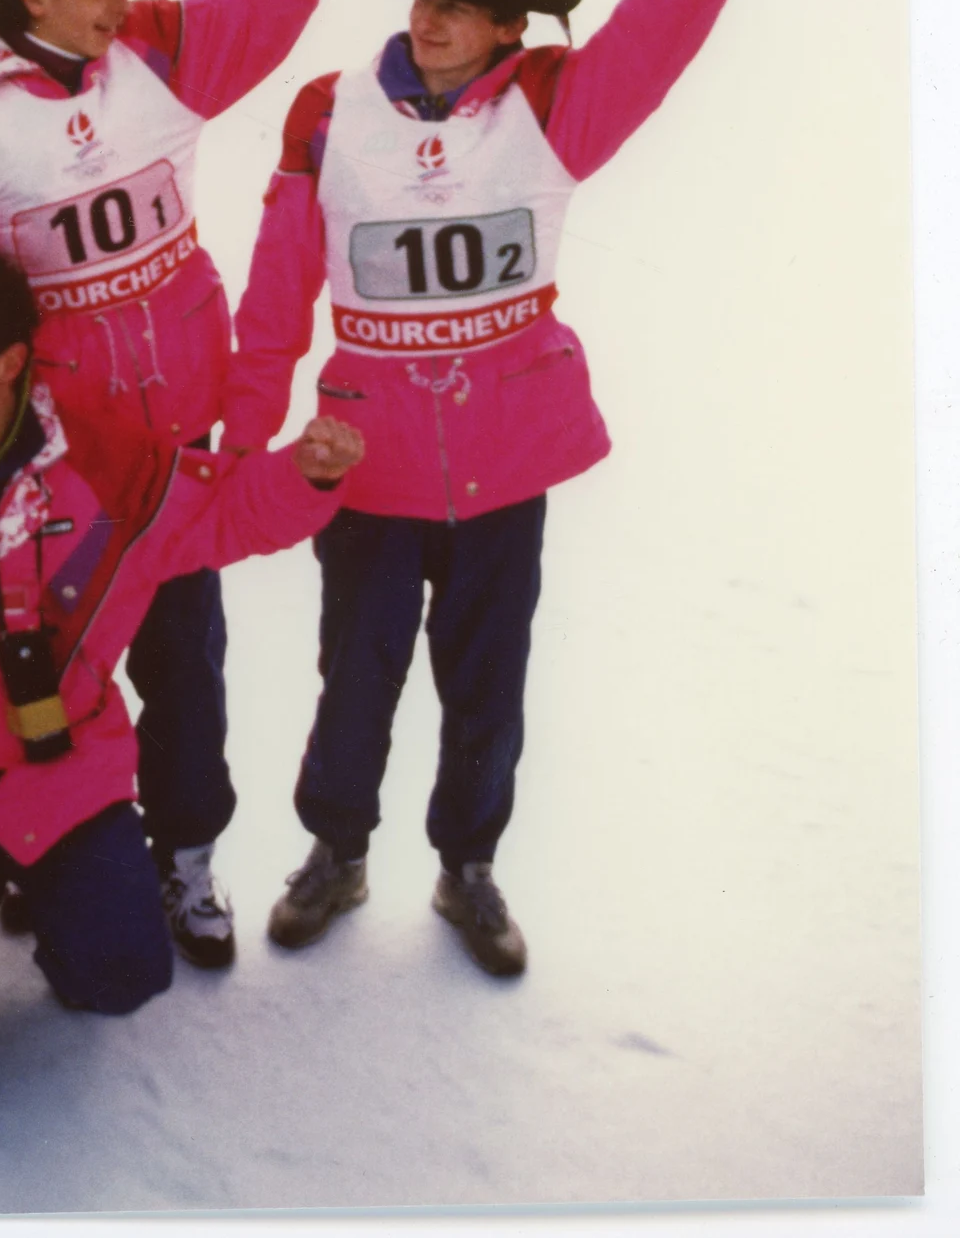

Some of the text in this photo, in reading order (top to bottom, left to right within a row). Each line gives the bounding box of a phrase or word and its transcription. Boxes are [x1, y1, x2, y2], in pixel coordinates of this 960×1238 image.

[50, 187, 167, 265] 10 1
[393, 223, 525, 294] 10 2
